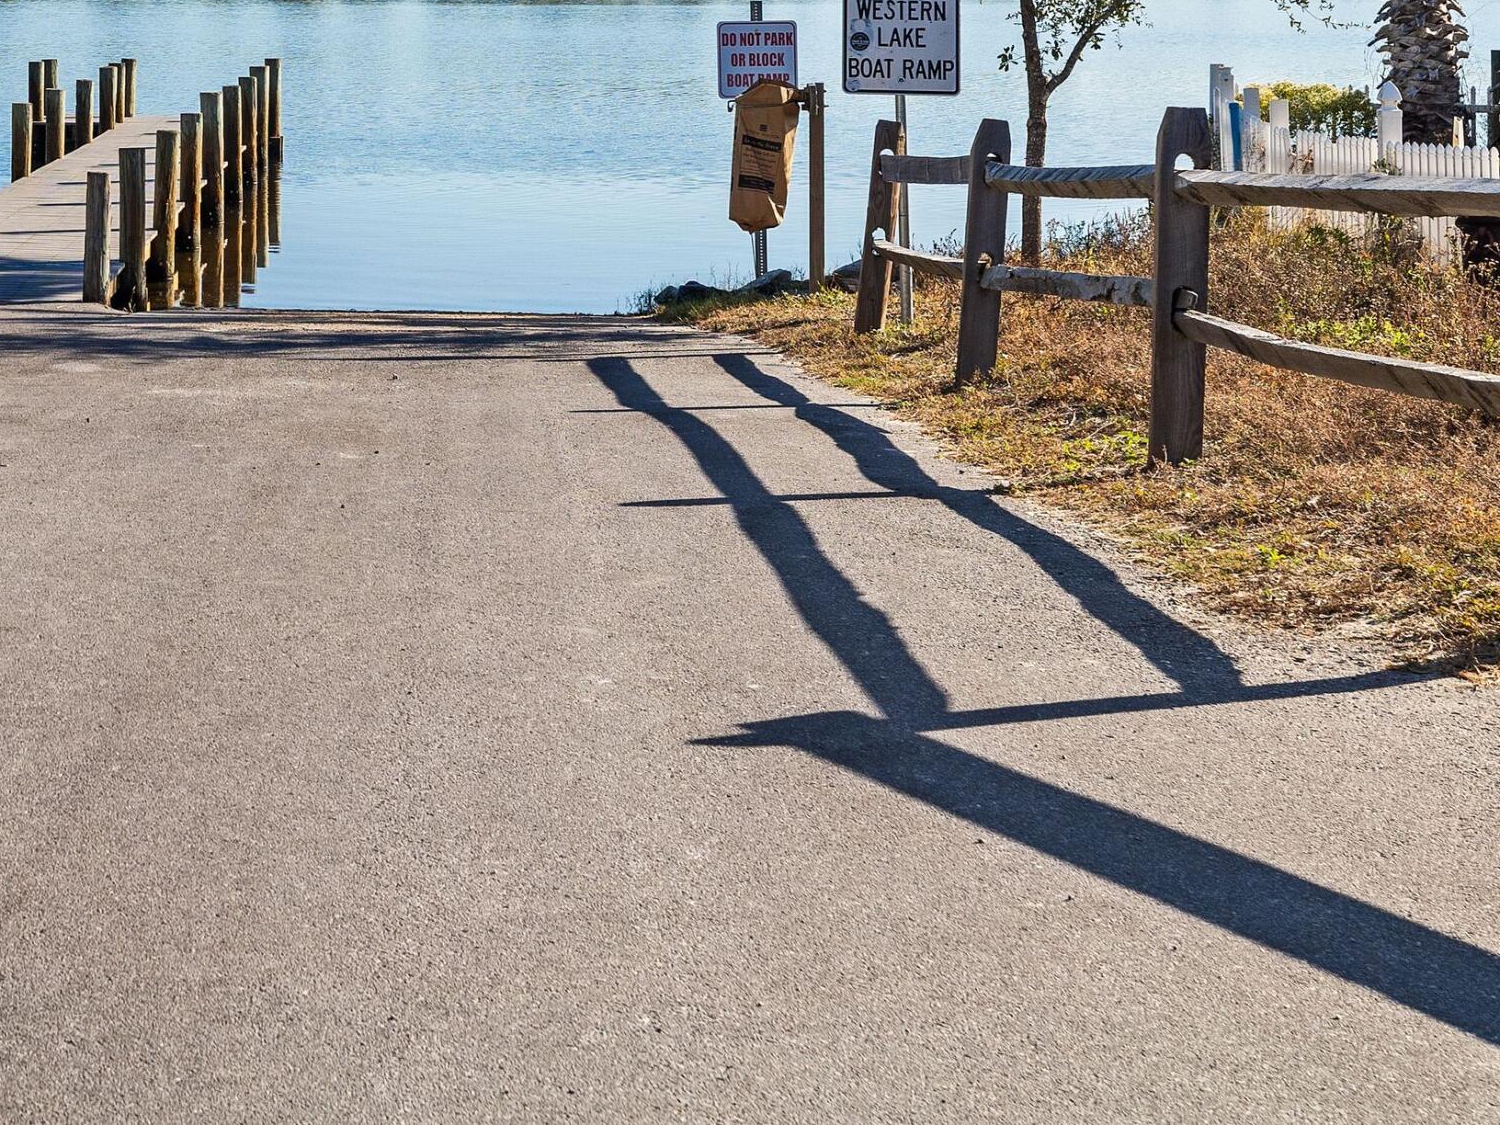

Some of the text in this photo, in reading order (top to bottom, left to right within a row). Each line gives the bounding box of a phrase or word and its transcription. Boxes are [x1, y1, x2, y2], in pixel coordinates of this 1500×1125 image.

[856, 0, 947, 22] WESTERN
[721, 32, 794, 47] DO NOT PARK
[877, 26, 927, 48] LAKE
[730, 52, 786, 67] OR BLOCK
[848, 58, 955, 80] BOAT RAMP
[726, 73, 755, 88] BOAT
